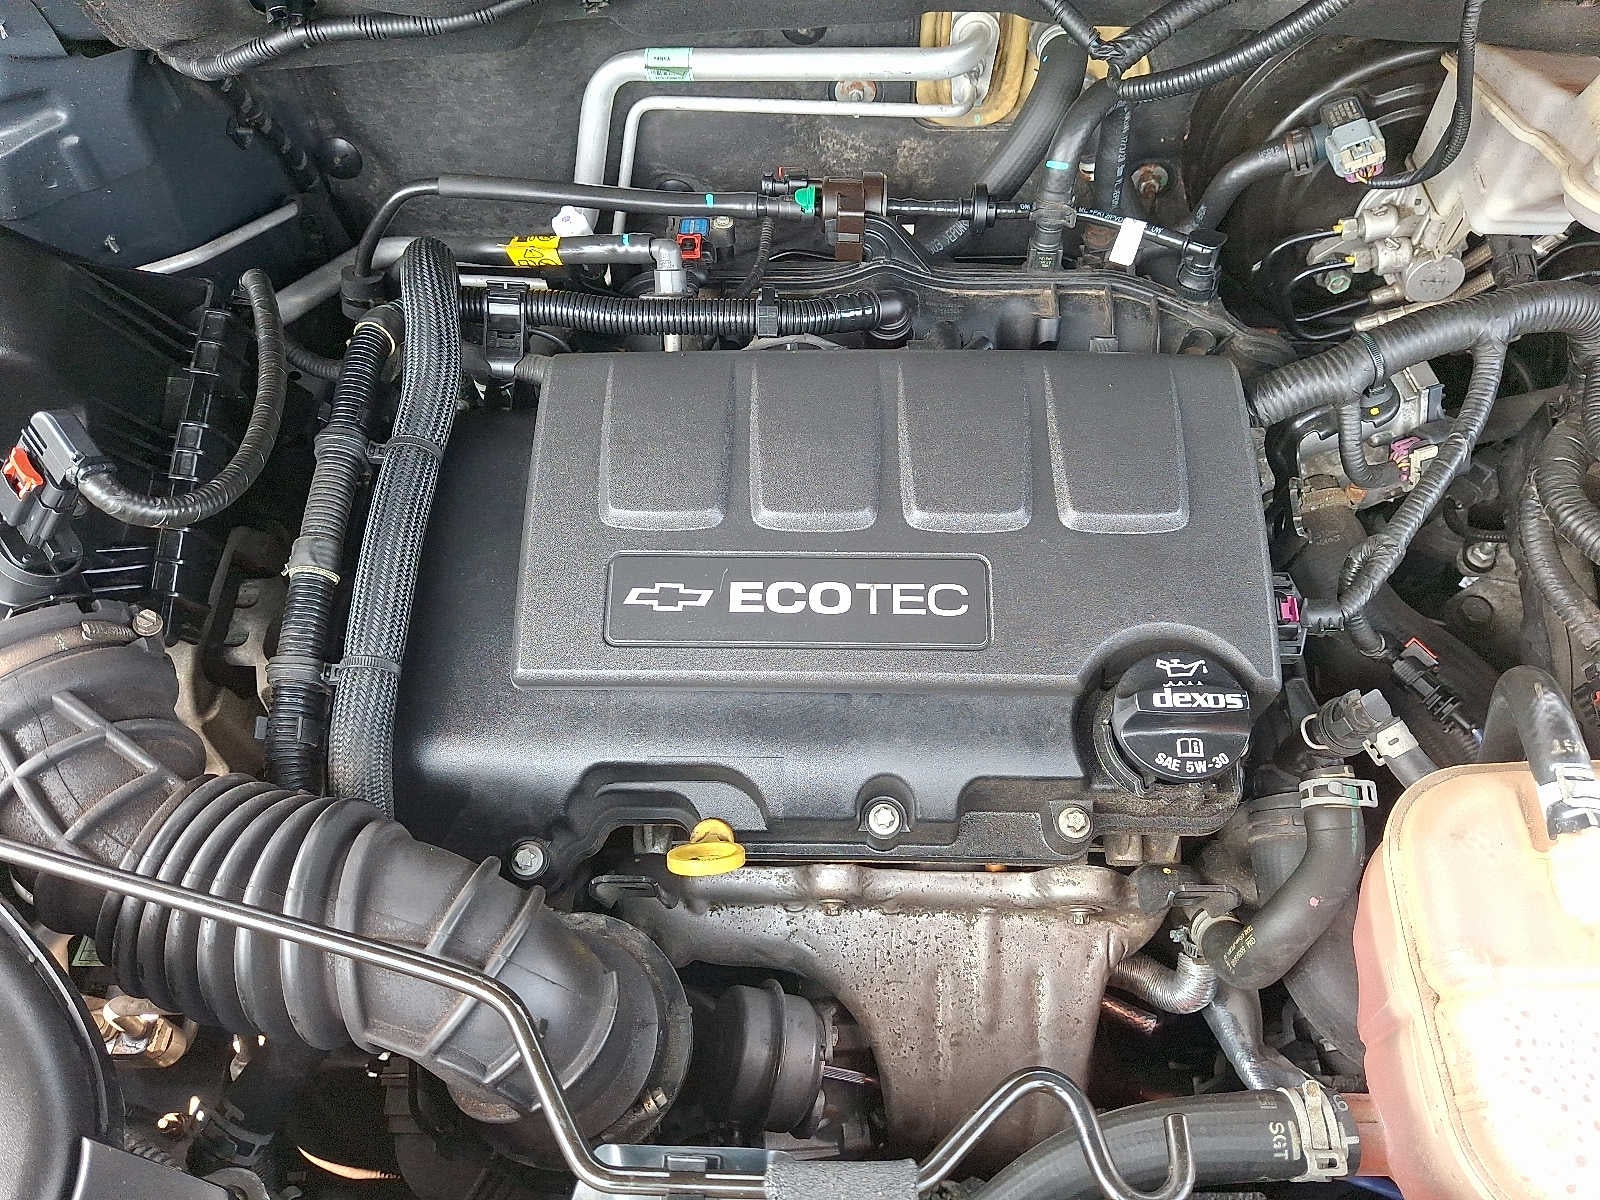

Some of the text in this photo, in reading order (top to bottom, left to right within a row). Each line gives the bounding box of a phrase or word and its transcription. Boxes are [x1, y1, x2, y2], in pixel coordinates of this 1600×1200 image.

[728, 581, 969, 616] ECOTEC
[1152, 688, 1244, 709] dexos
[1154, 752, 1230, 774] SAE 5W-30
